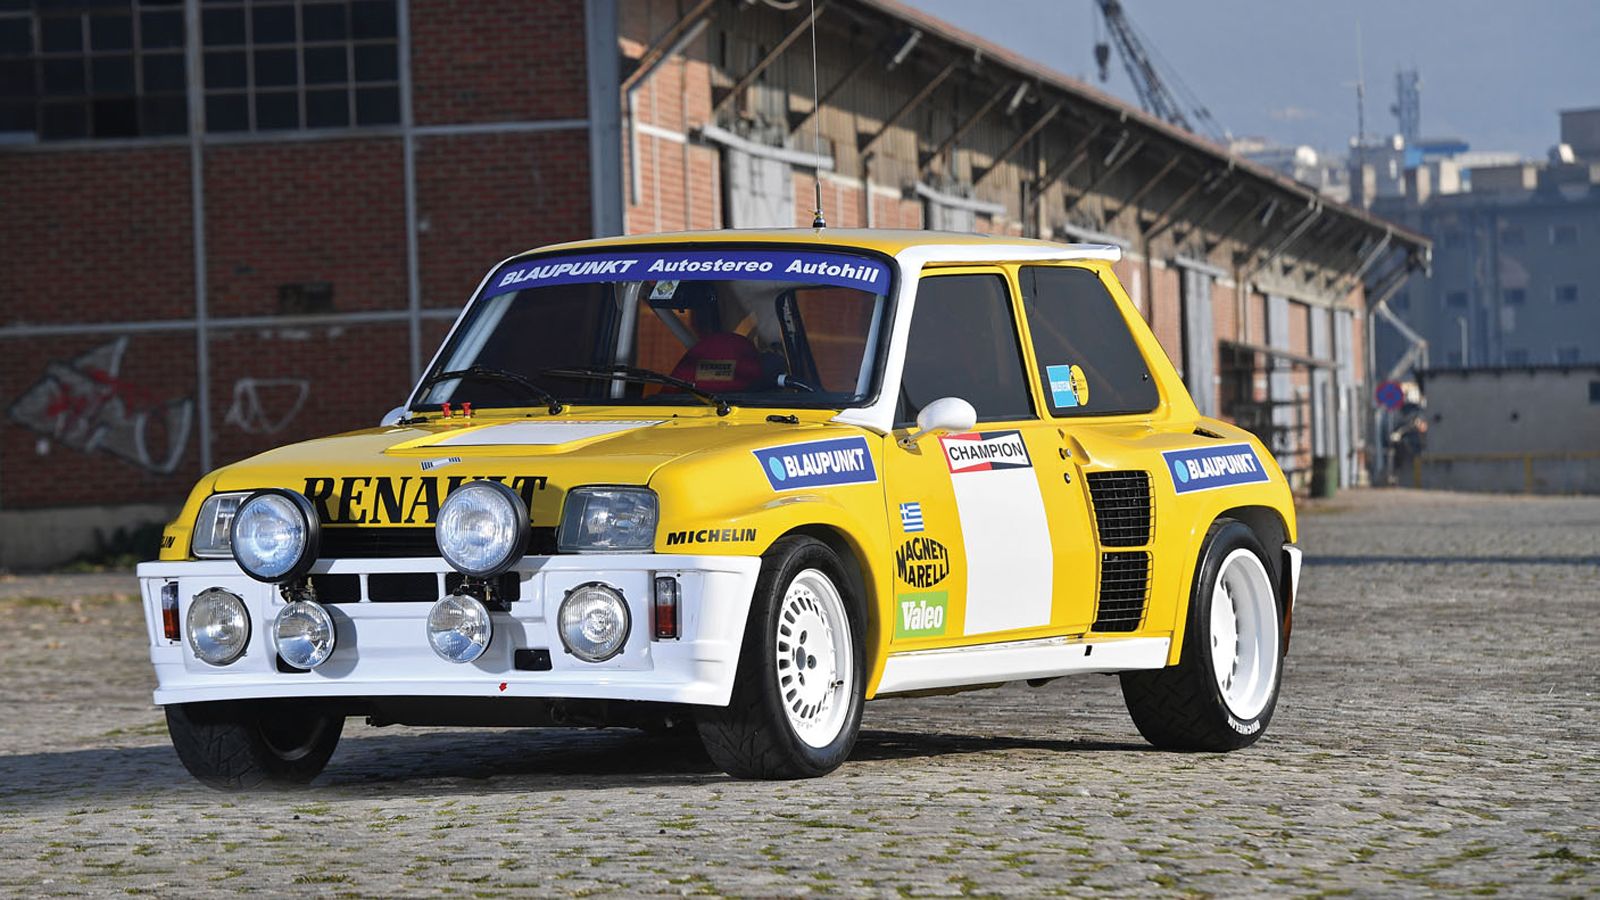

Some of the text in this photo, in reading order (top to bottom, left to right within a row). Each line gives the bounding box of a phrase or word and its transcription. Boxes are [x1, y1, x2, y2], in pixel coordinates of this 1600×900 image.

[499, 258, 880, 288] BLAUPUNKT Autostereo Autohill
[783, 448, 865, 478] BLAUPUNKT
[949, 442, 1023, 460] CHAMPION
[1188, 455, 1257, 478] BLAUPUNKT
[666, 528, 757, 546] MICHELIN
[896, 537, 949, 570] MAGNETI
[896, 556, 949, 588] MARELLI
[901, 600, 943, 630] Valeo
